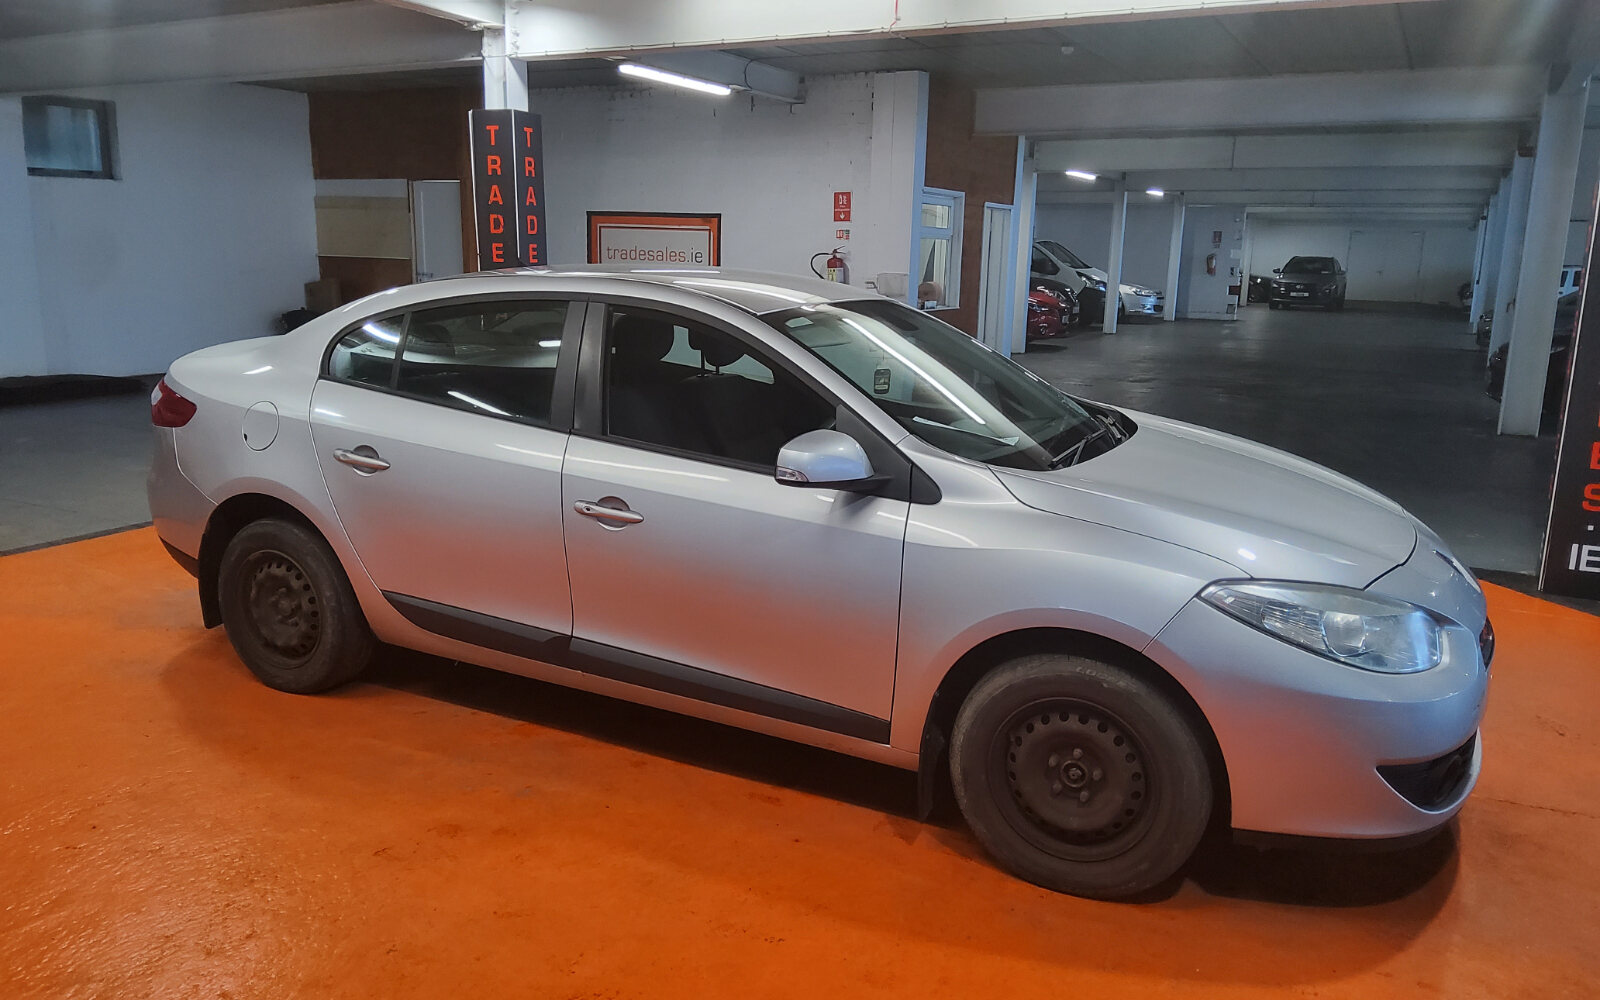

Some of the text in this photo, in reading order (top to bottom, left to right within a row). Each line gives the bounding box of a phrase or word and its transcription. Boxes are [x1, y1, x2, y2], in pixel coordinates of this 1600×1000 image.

[486, 125, 505, 263] TRADE
[524, 127, 538, 264] TRADE
[607, 245, 703, 264] tradesales.ie
